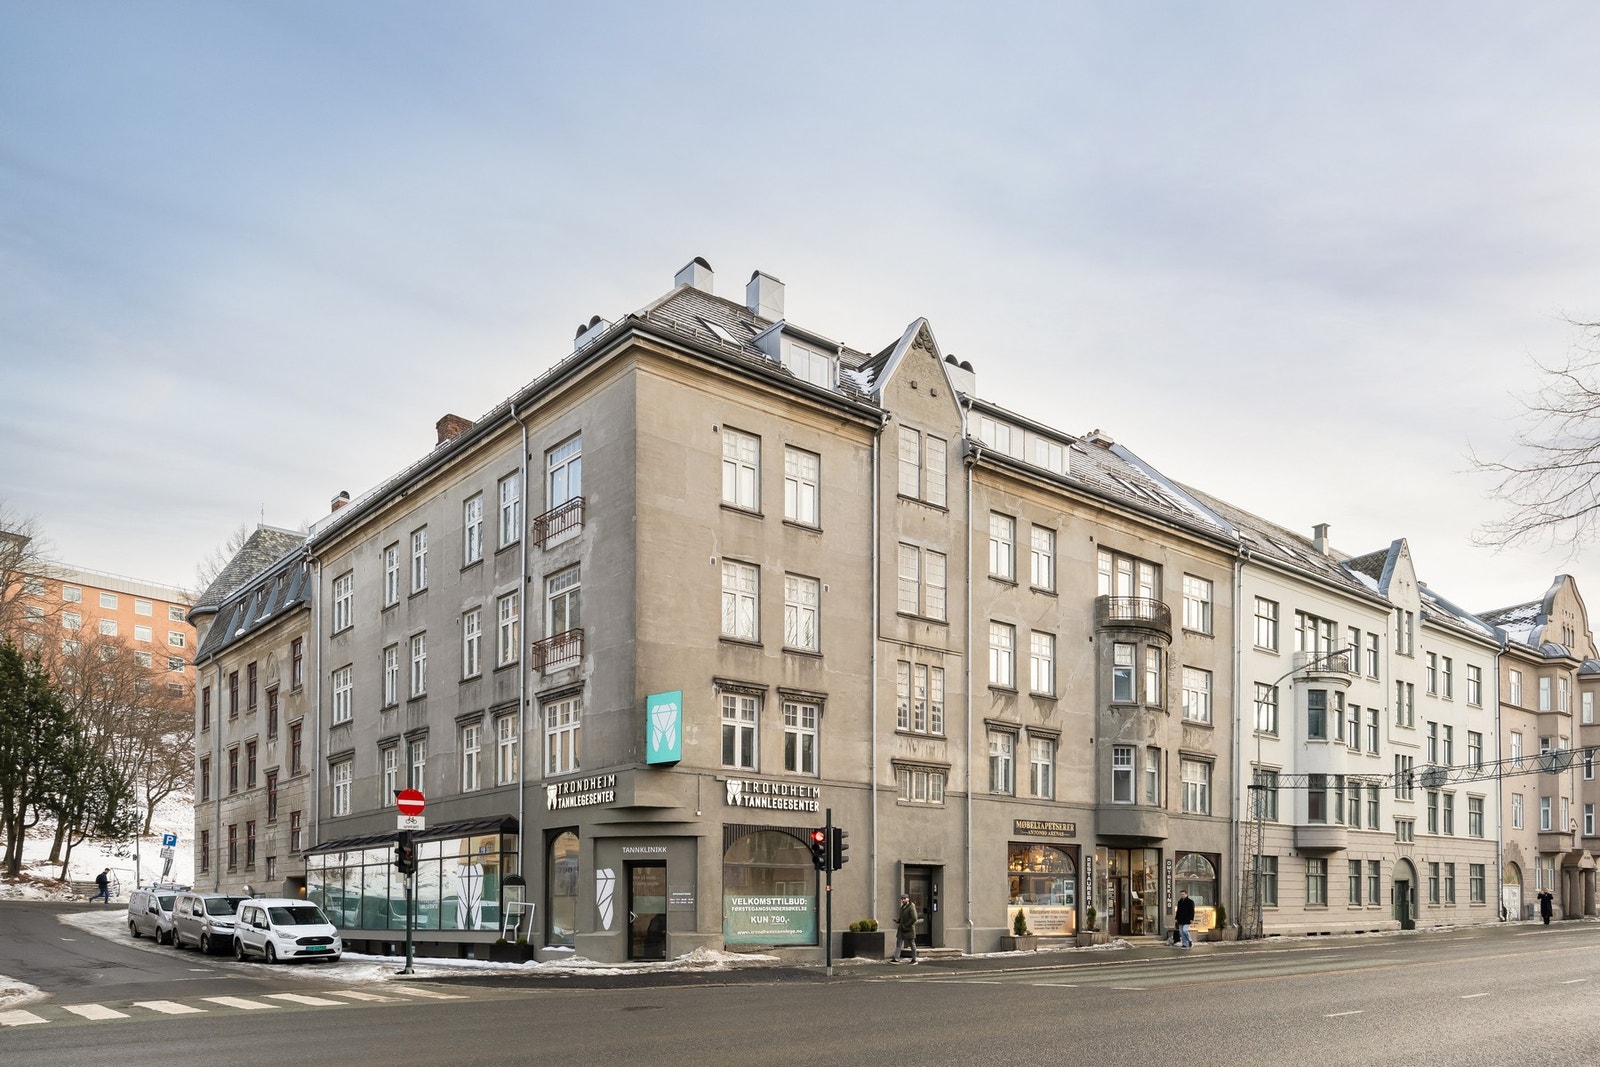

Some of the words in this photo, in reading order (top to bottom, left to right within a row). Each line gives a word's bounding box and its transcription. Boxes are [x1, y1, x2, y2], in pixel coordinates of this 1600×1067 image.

[558, 774, 616, 794] TRONDHEIM
[744, 781, 820, 798] TRONDHEIM
[558, 790, 614, 808] TANNLEGESENTER
[744, 796, 820, 812] TANNLEGESENTER
[1016, 821, 1075, 831] MØBELTAPETSERER
[166, 836, 174, 845] P
